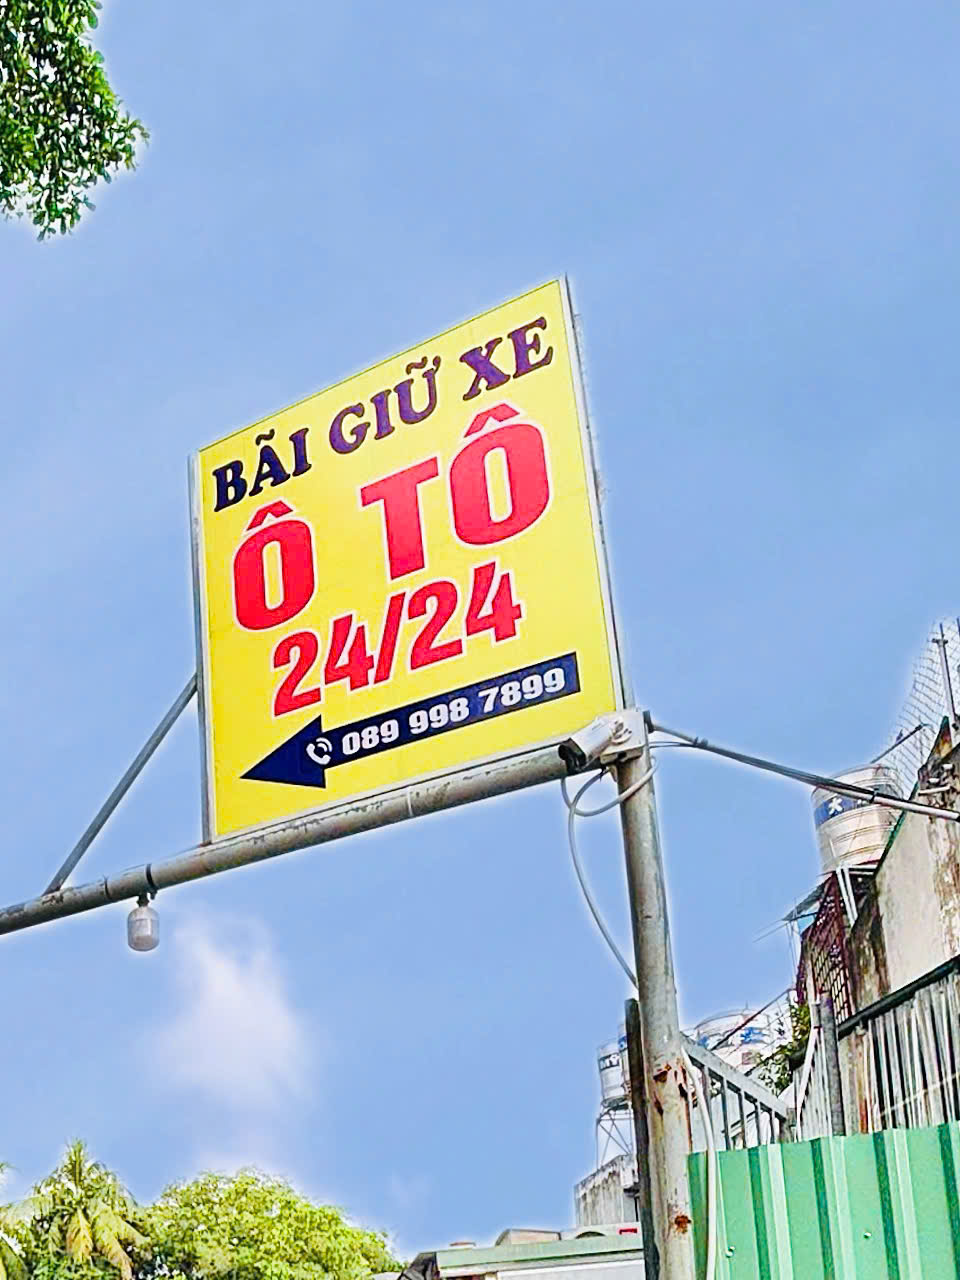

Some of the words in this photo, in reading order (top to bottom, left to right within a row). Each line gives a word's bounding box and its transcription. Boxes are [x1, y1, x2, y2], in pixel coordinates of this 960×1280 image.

[212, 428, 313, 513] BÃI
[328, 355, 441, 455] GIỮ
[458, 316, 554, 401] XE
[232, 499, 316, 631] Ô
[360, 402, 551, 580] TÔ
[272, 560, 523, 718] 24/24
[342, 719, 399, 756] 089
[408, 697, 470, 734] 998
[478, 667, 566, 713] 7899
